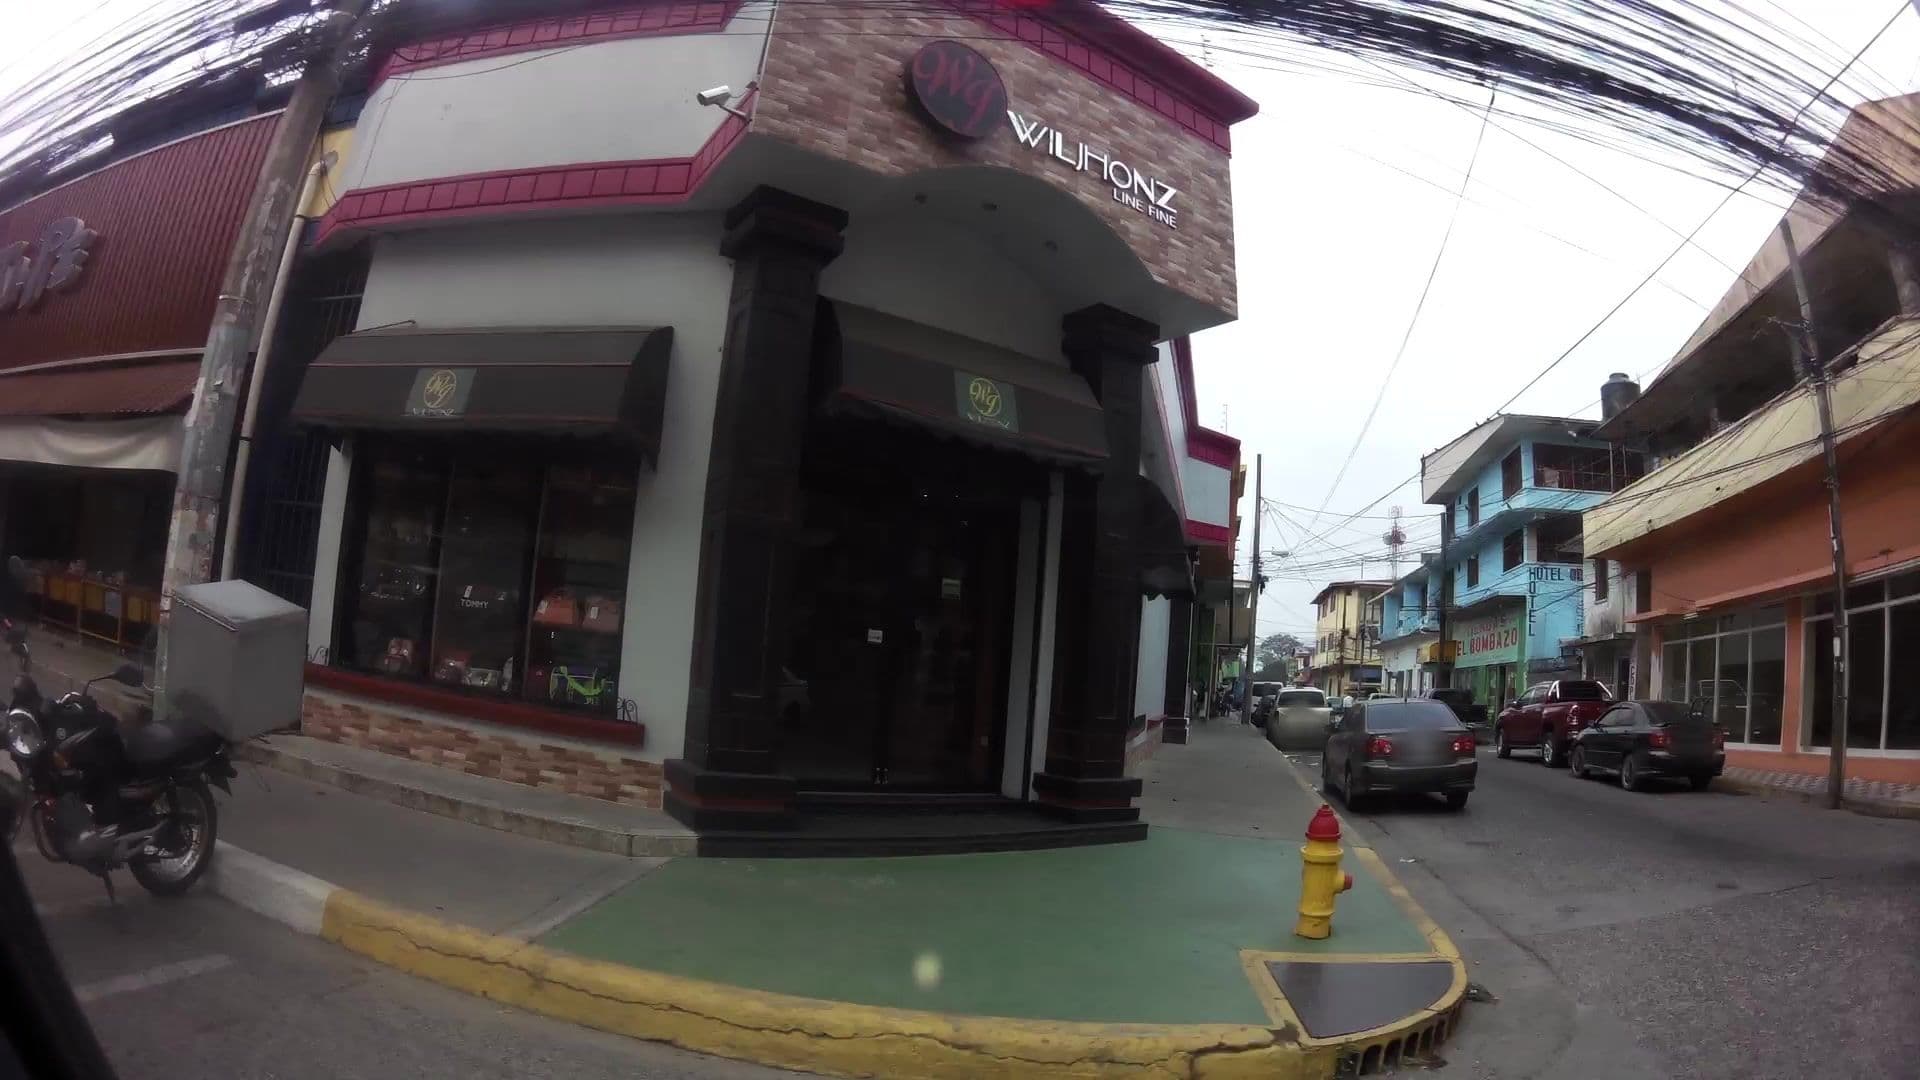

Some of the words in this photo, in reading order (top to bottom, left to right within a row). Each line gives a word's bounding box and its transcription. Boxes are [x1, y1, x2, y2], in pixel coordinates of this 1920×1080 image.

[1006, 109, 1178, 214] WILJHONZ
[1112, 187, 1145, 213] LINE
[1147, 203, 1178, 229] FINE
[1528, 567, 1565, 581] HOTEL
[460, 598, 489, 609] TOMMY
[1457, 639, 1467, 657] EL
[1470, 628, 1518, 655] BOMBAZO
